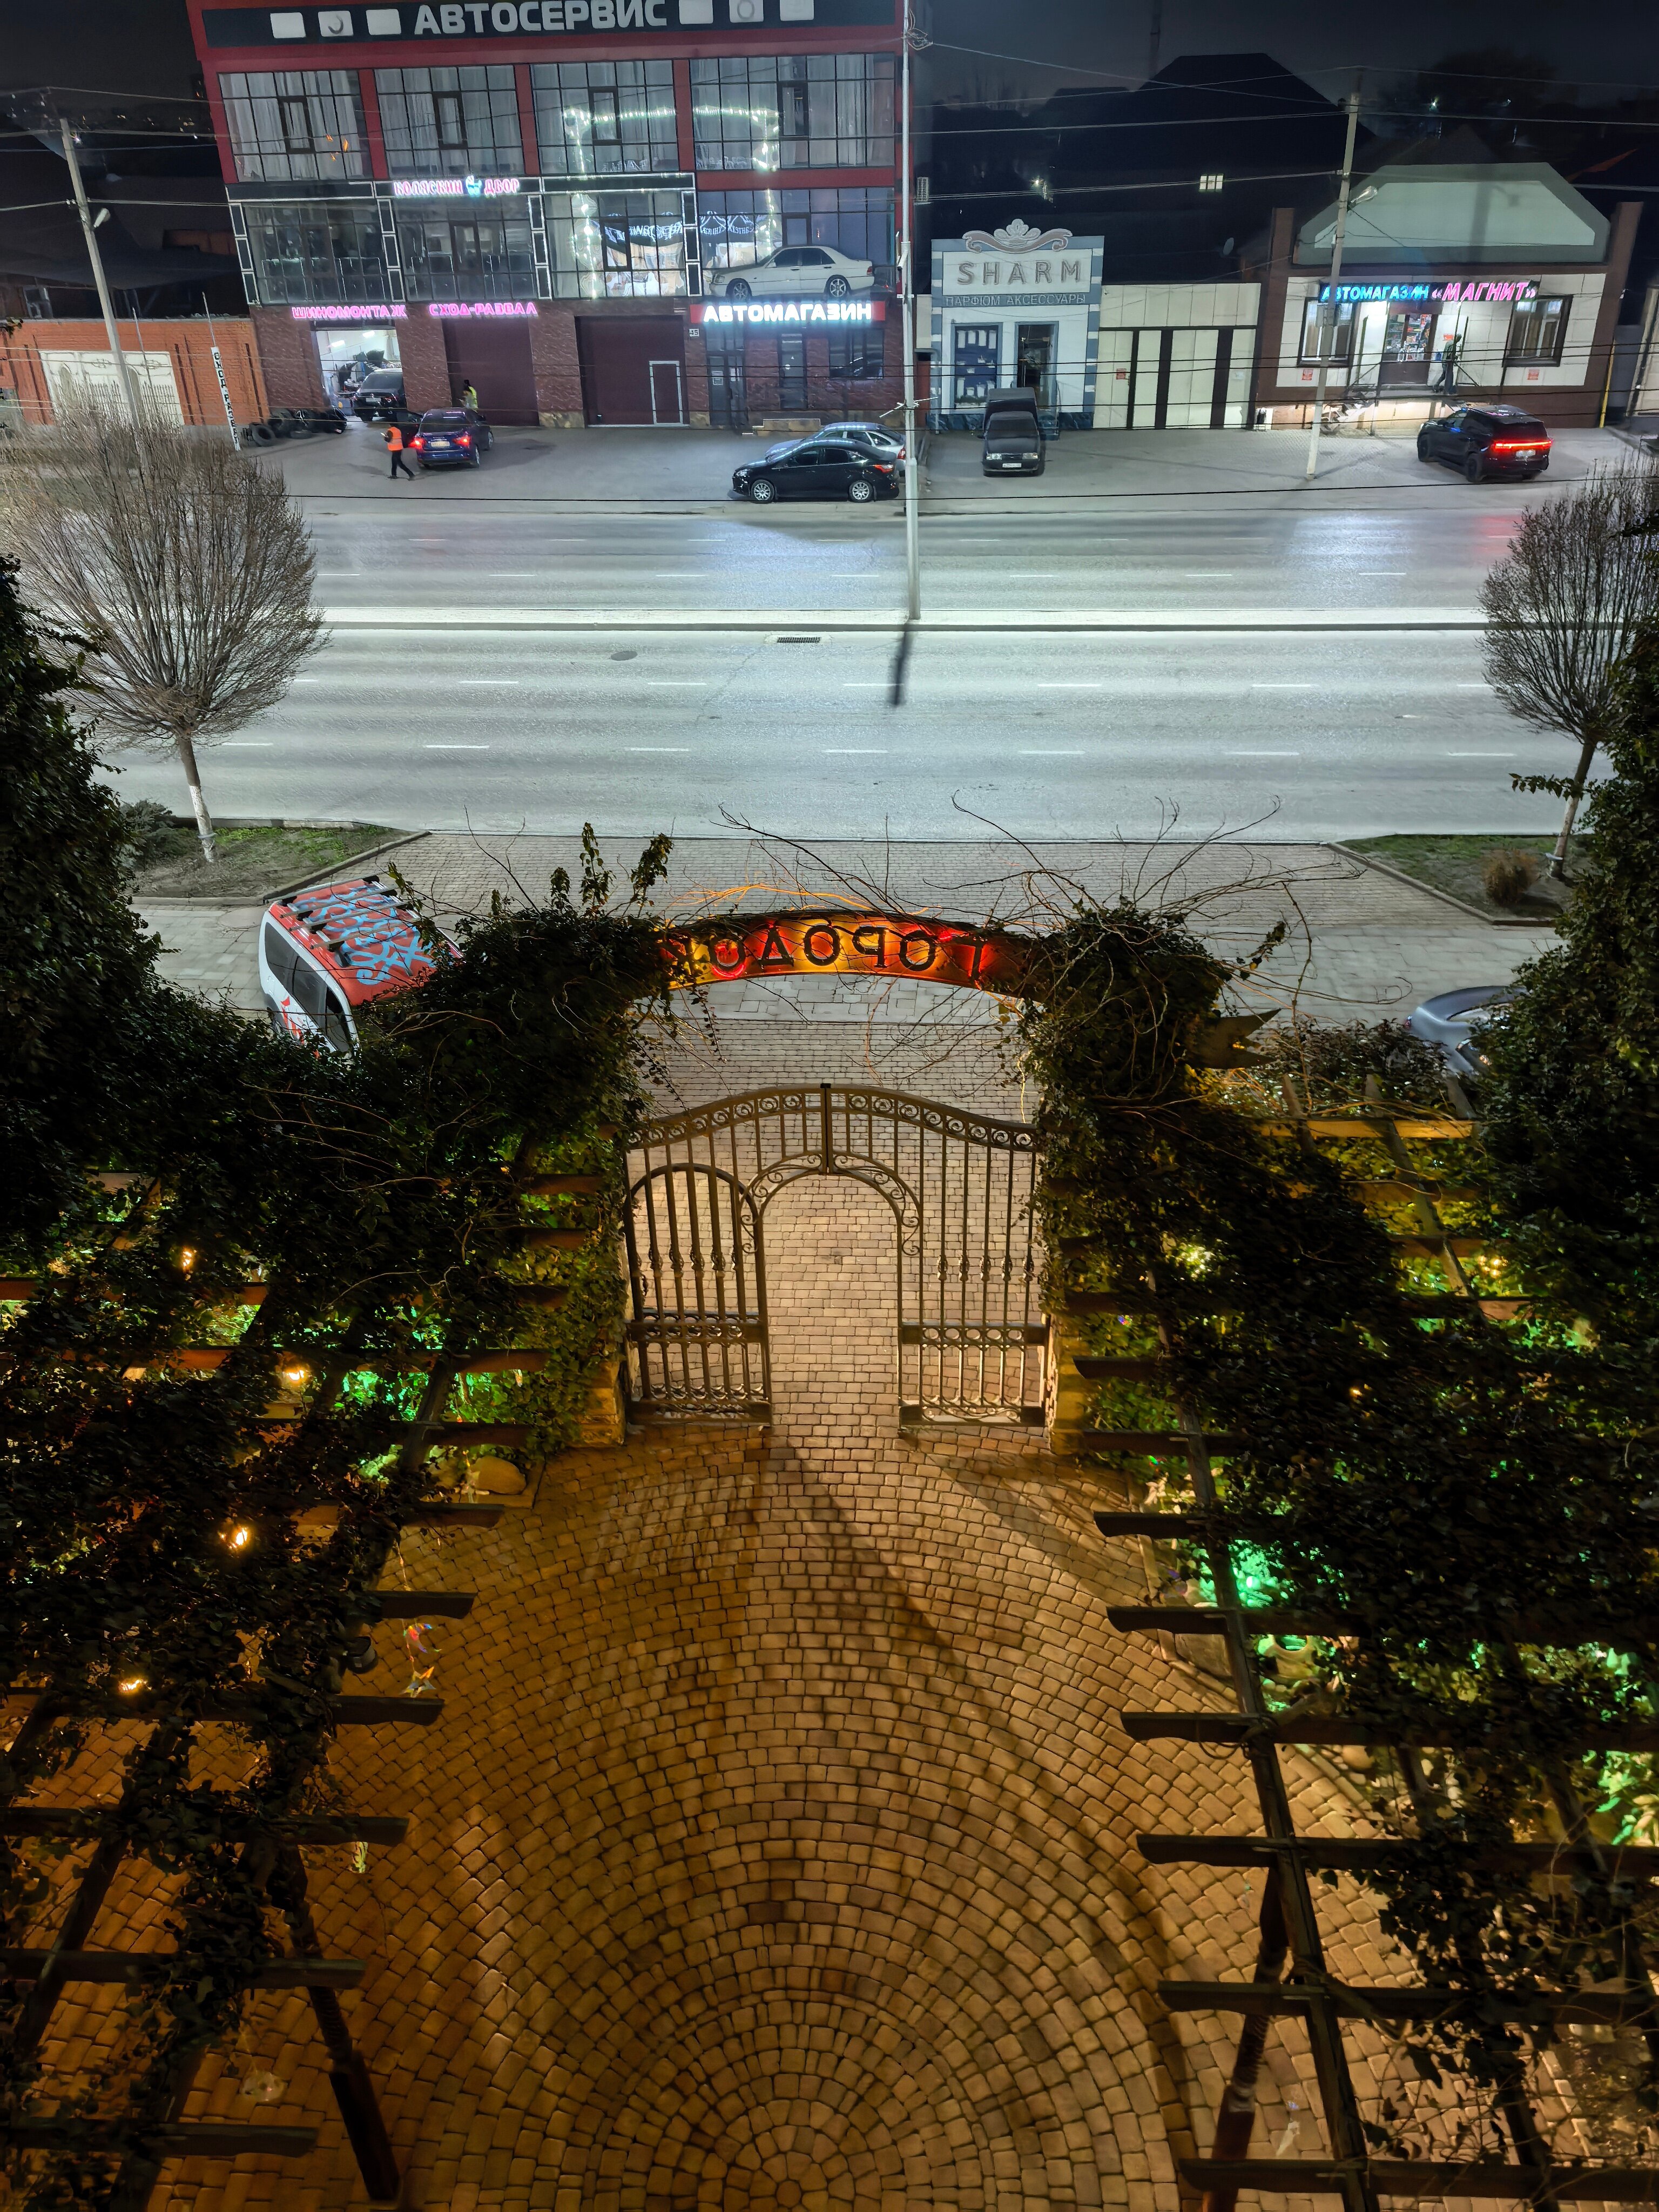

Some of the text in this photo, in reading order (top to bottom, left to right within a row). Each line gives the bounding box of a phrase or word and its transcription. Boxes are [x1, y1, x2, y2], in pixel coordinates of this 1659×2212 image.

[414, 0, 667, 35] АВТОСЕРВИС
[393, 178, 520, 197] КОЛЯСКИН ДВОР
[957, 259, 1081, 285] SHARM
[429, 302, 538, 316] СХОД-РАЗВАЛ
[946, 294, 1085, 306] ПАРФЮМ АКСЕССУАРЫ
[292, 305, 407, 319] ШИНОМОНТАЖ
[703, 303, 872, 322] АВТОМАГАЗИН
